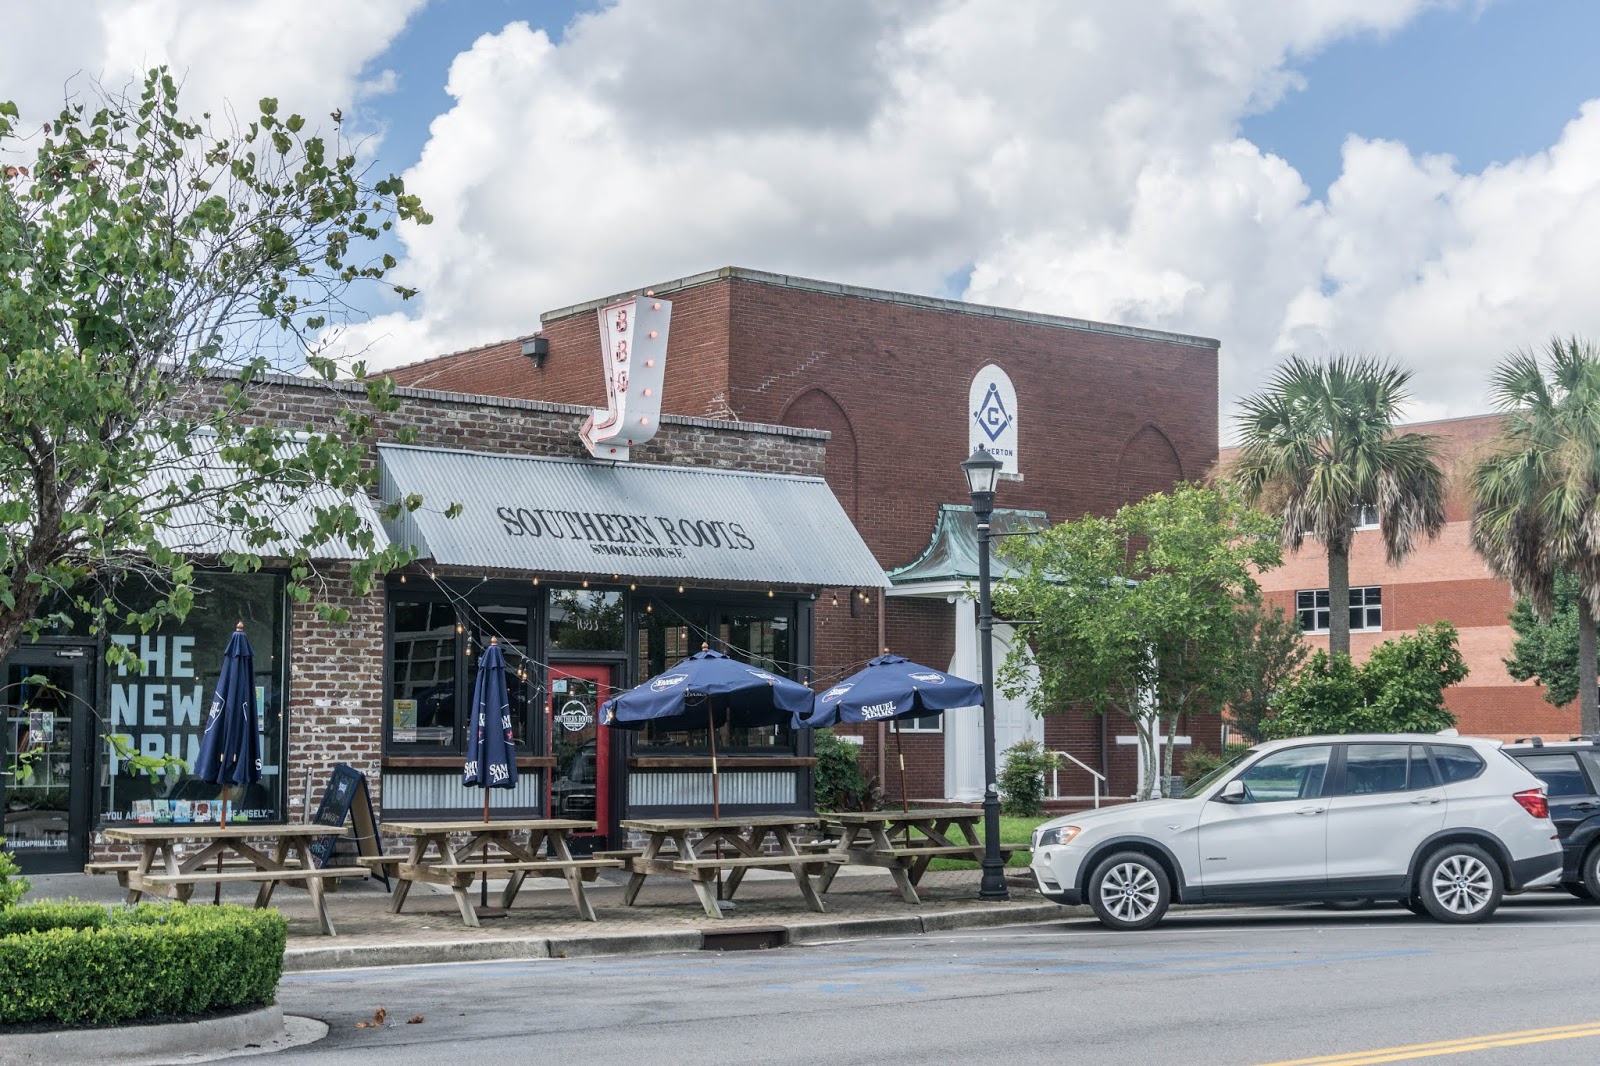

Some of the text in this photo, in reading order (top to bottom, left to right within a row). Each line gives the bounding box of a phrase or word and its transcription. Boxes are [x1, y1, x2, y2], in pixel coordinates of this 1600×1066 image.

[616, 310, 628, 393] BBQ
[987, 407, 999, 425] G
[497, 507, 755, 550] SOUTHERN ROOTS
[590, 544, 686, 558] SMOKEHOUSE
[111, 635, 195, 677] THE
[111, 684, 203, 726] NEW
[861, 701, 896, 716] SAMUEL
[554, 715, 593, 723] SOUTHERN ROOTS
[865, 708, 894, 720] ADAMS
[110, 734, 278, 775] PRIL
[106, 811, 122, 820] YOU
[6, 840, 67, 848] THENEWPRIMAL.COM
